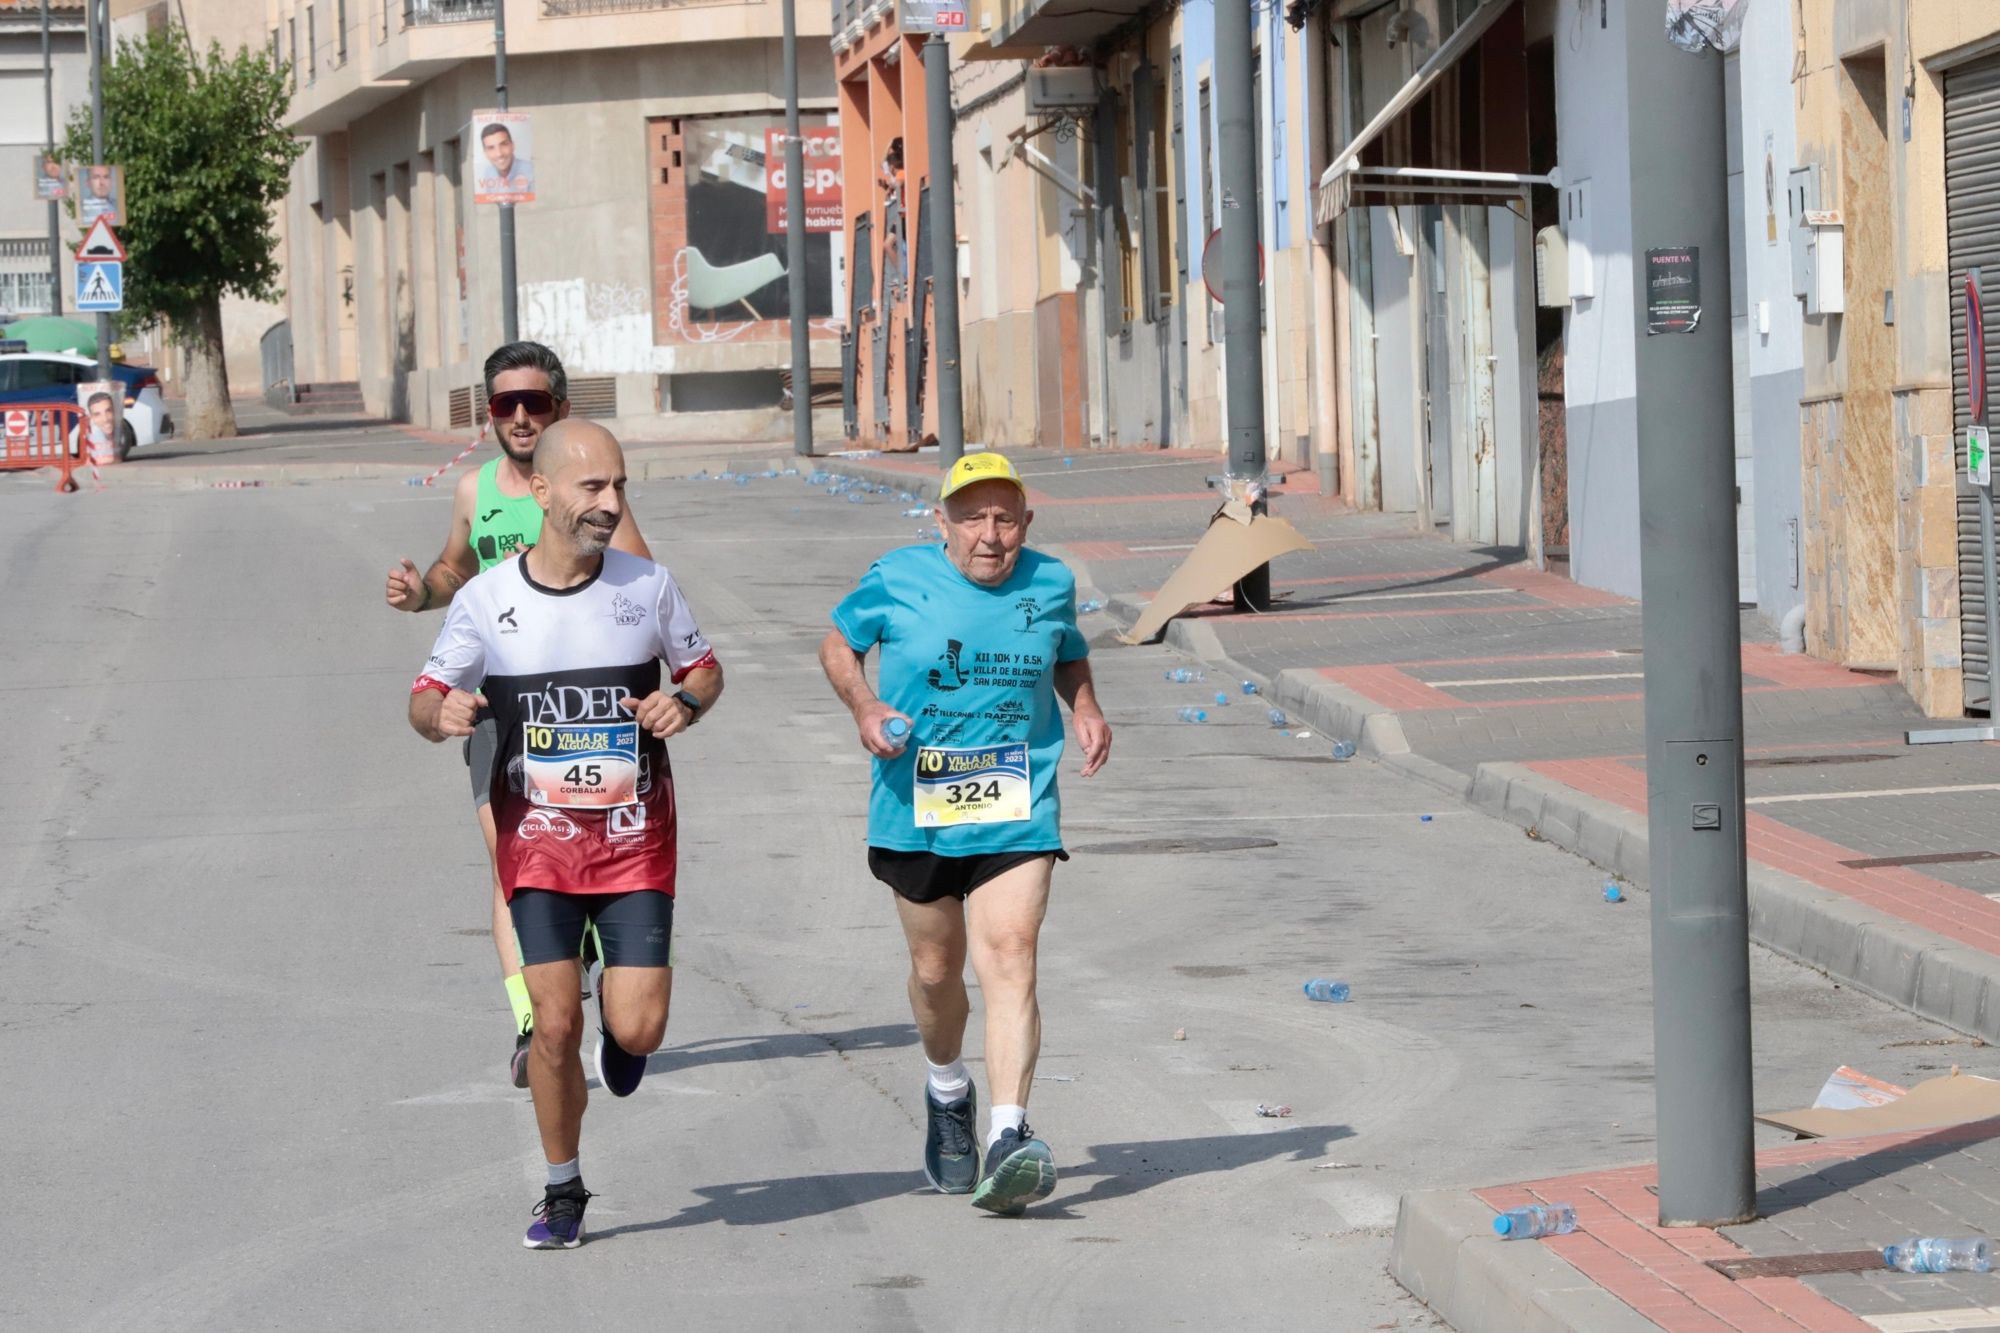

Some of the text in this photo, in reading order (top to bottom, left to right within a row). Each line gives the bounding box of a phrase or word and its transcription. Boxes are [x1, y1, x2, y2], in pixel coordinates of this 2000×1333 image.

[974, 666, 1042, 677] VILLA DE BLANCA
[973, 677, 990, 686] SAN
[992, 679, 1018, 687] PEDRO
[984, 713, 1030, 721] RAFTING
[557, 733, 608, 743] VILLA DE
[616, 737, 634, 746] 2023
[557, 742, 608, 750] ALGUAZAS
[948, 756, 980, 766] VILLA
[983, 752, 997, 763] DE
[948, 763, 997, 772] ALGUAZAS
[564, 765, 602, 786] 45
[946, 780, 1001, 804] 324
[955, 803, 992, 811] ANTONIO
